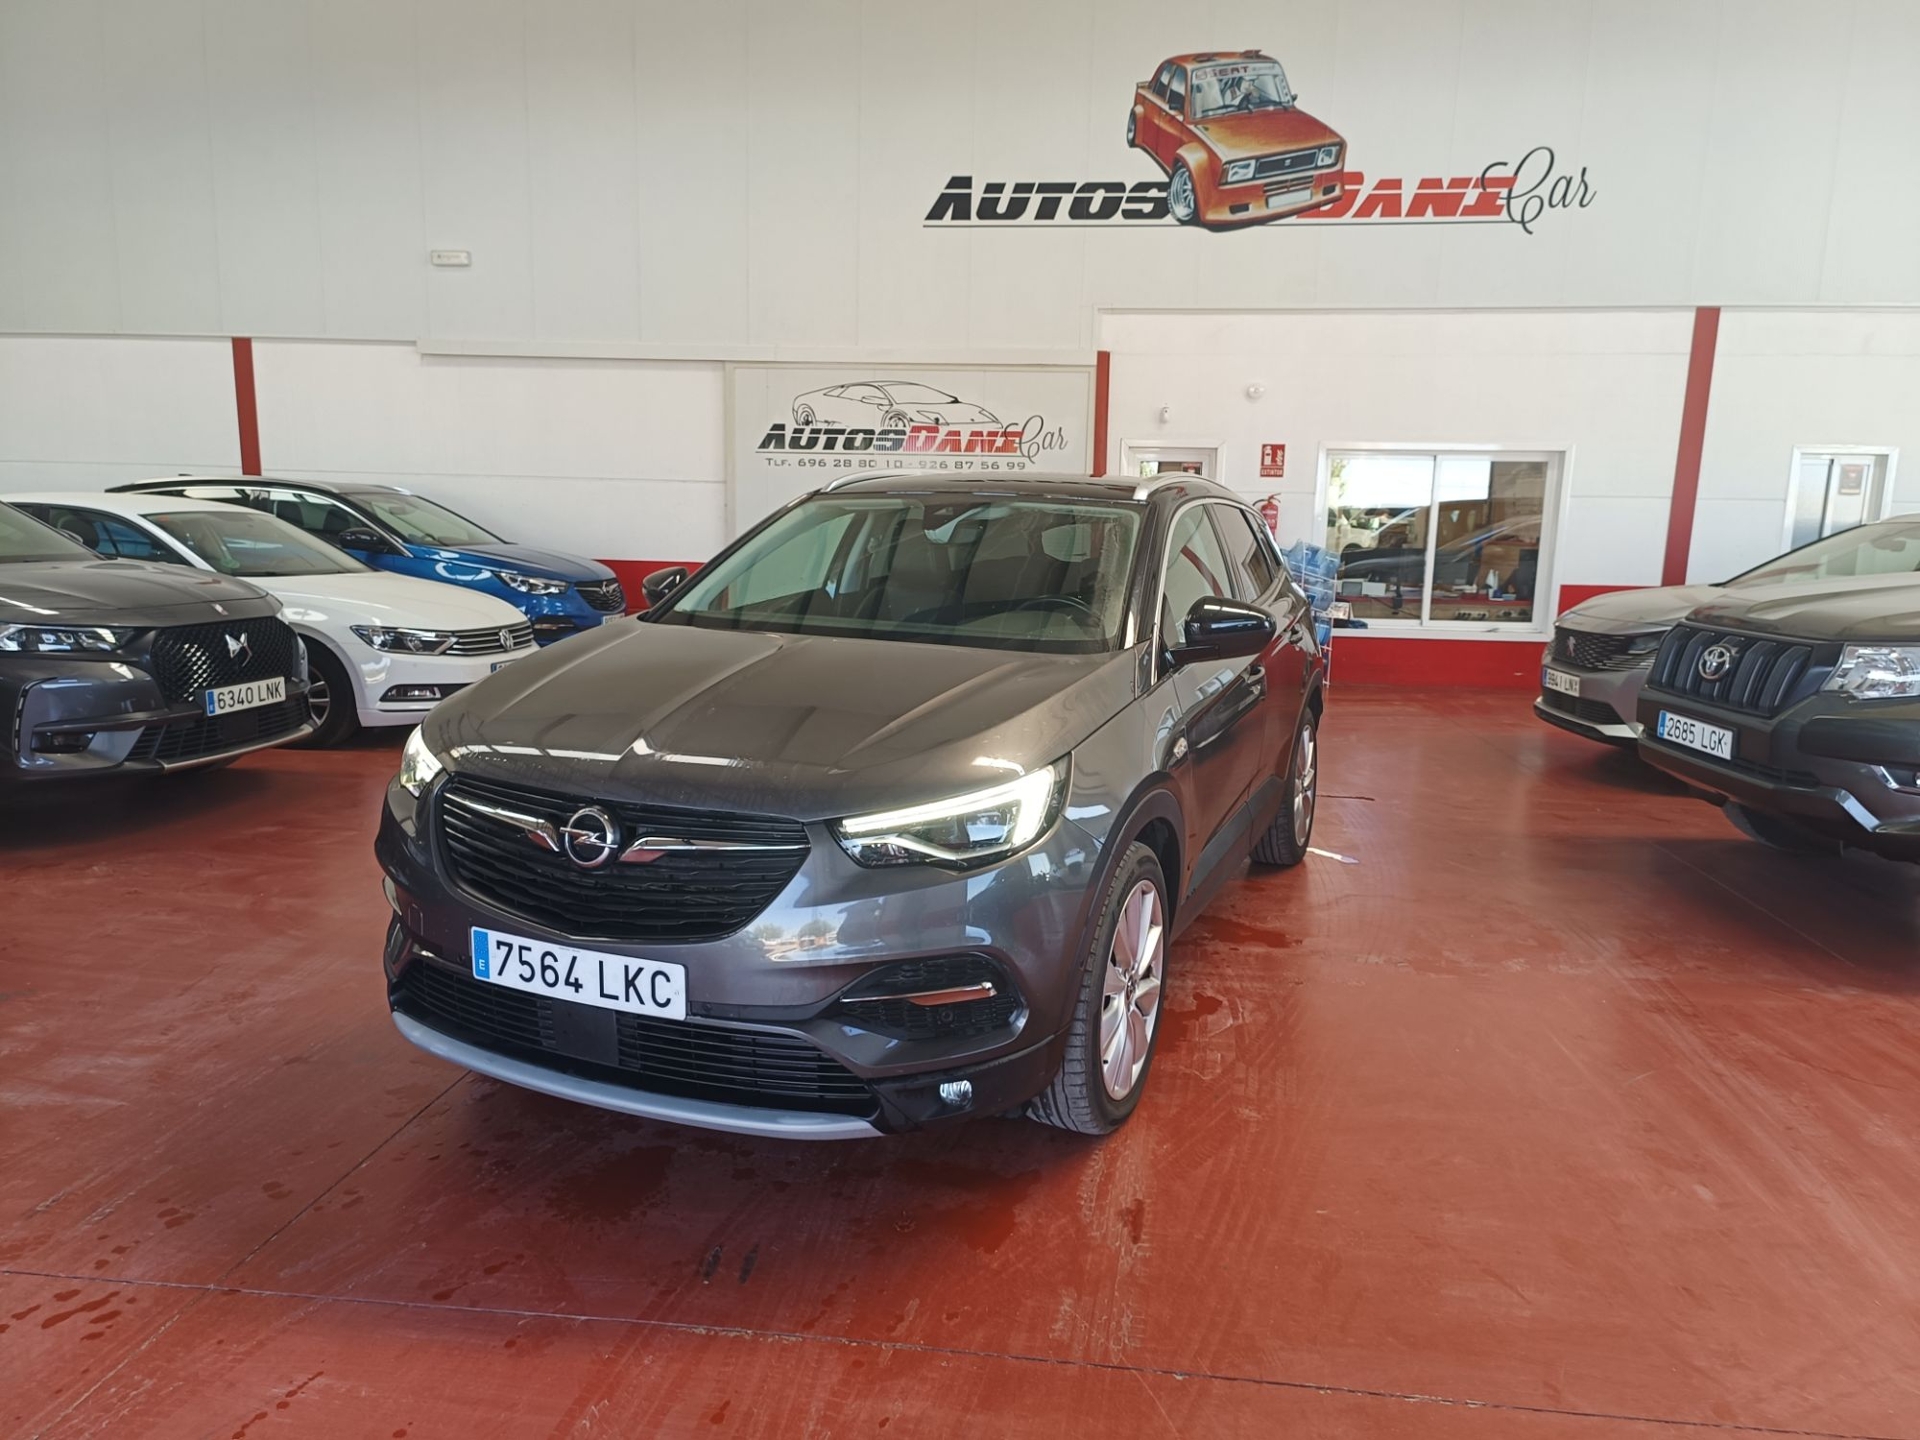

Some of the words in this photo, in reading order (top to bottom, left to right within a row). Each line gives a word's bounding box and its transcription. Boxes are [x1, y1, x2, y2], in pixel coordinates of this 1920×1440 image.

[924, 176, 1171, 220] AUTOS
[1295, 171, 1518, 219] DANI
[1481, 146, 1598, 236] Car
[757, 423, 907, 452] AUTOS
[1004, 414, 1068, 464] Car
[797, 458, 827, 468] 696
[833, 459, 852, 468] 28
[858, 459, 878, 468] 80
[886, 459, 903, 469] 10
[918, 460, 949, 470] 926
[954, 460, 974, 470] 87
[980, 461, 1000, 470] 56
[1006, 461, 1026, 470] 99
[217, 687, 254, 710] 6340
[257, 681, 282, 702] LNK
[1667, 717, 1696, 744] 2685
[1701, 727, 1726, 754] LGK
[479, 959, 486, 970] E
[496, 939, 583, 993] 7564
[598, 959, 672, 1008] LKC
